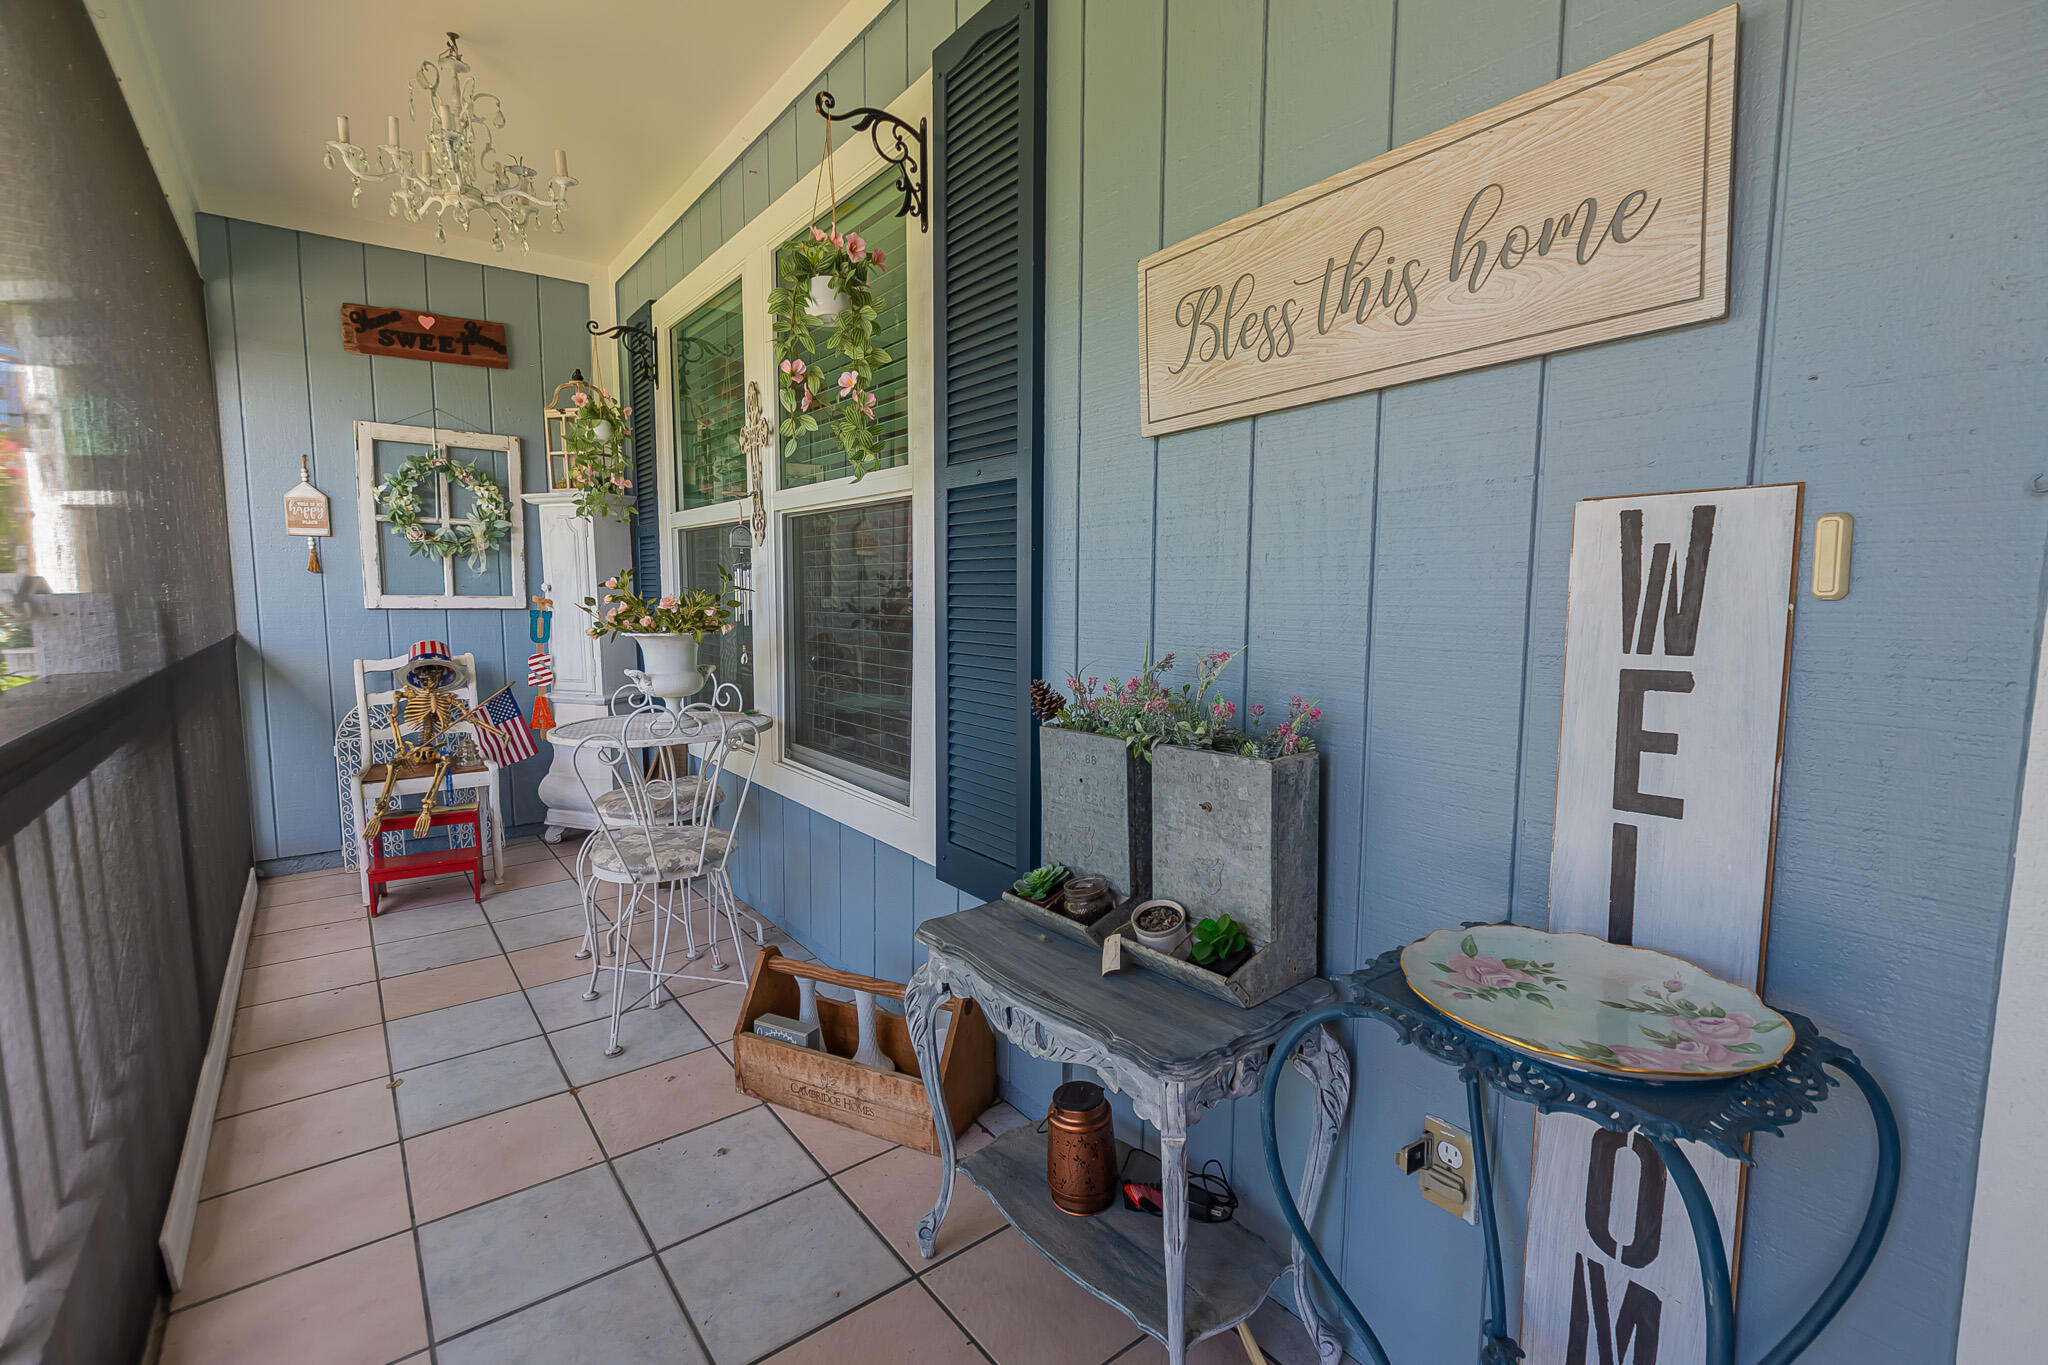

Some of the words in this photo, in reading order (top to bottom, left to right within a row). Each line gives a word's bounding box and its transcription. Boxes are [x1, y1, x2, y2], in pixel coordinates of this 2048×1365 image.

[1168, 272, 1303, 375] Bless
[1294, 226, 1429, 335] this
[1449, 183, 1662, 293] home
[378, 329, 472, 356] SWEET
[528, 610, 557, 730] USA
[843, 1097, 875, 1118] HOMES
